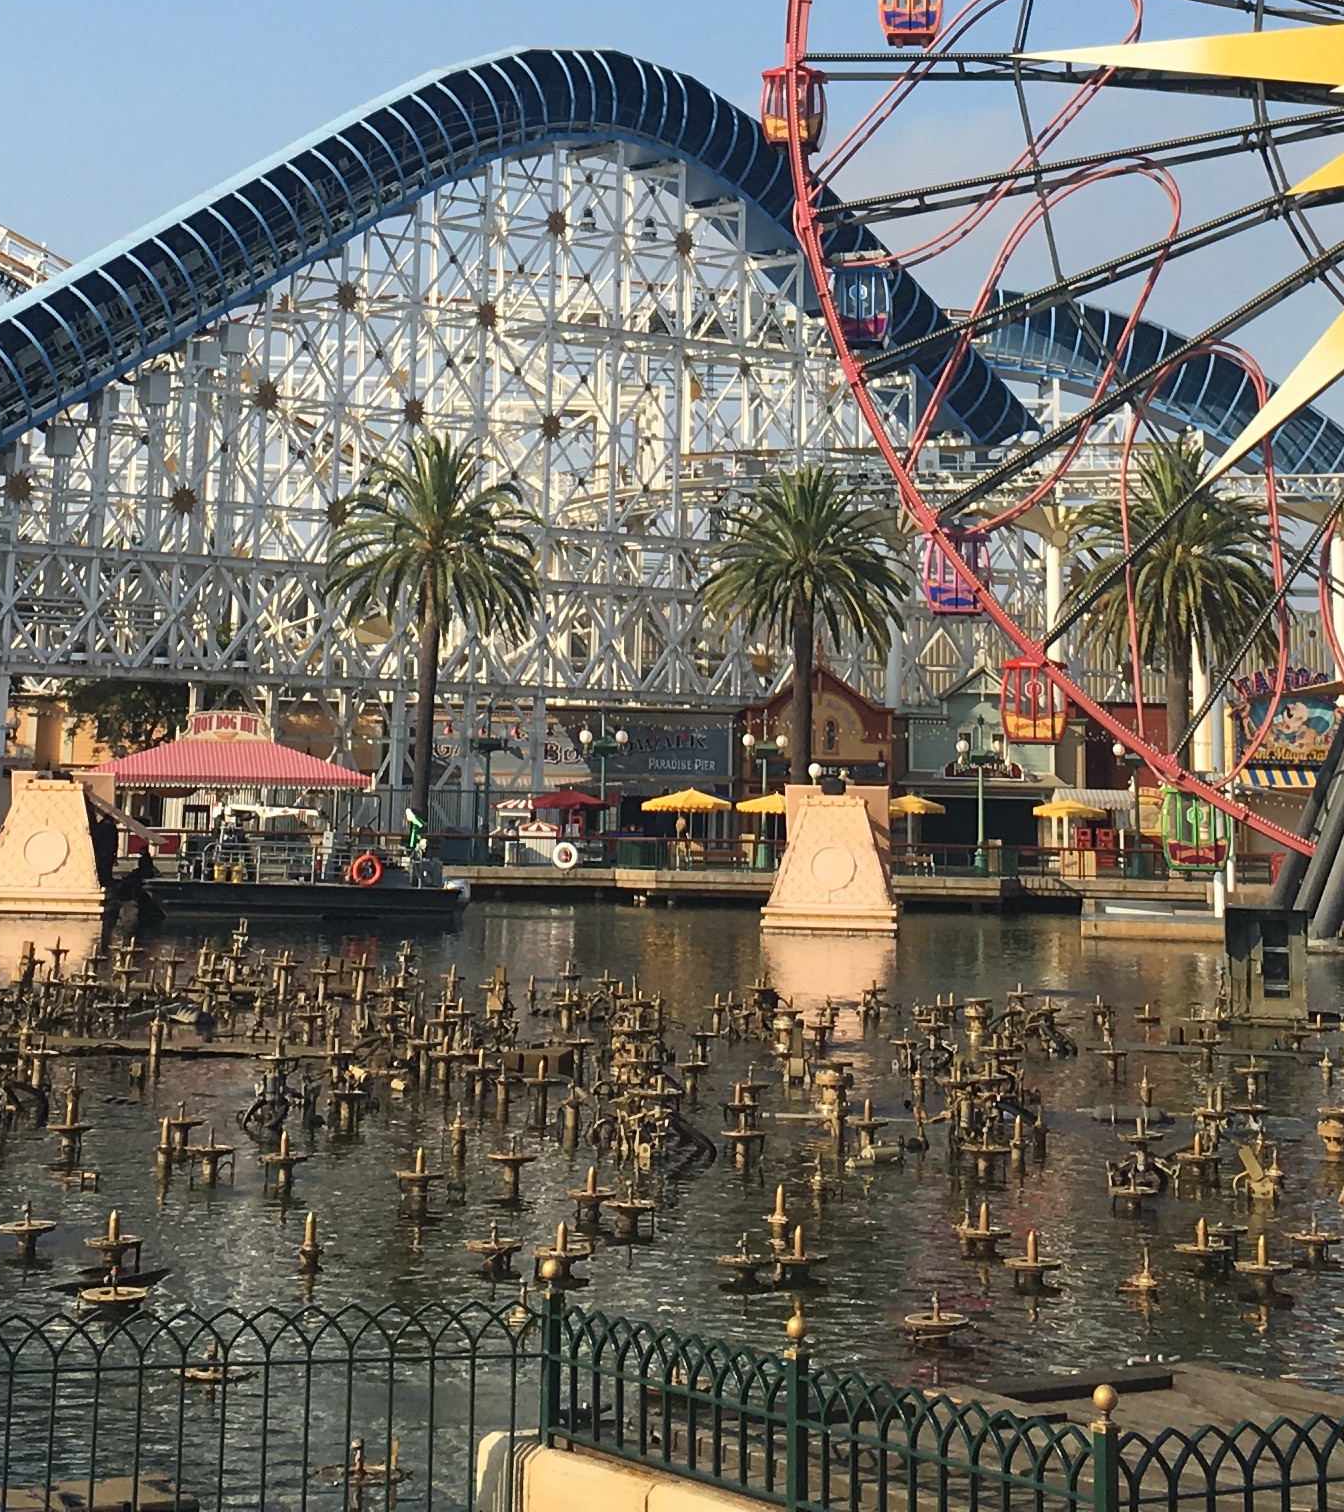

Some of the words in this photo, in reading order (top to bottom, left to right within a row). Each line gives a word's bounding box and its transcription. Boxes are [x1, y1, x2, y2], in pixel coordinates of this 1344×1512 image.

[193, 715, 214, 736] HOT
[216, 714, 237, 730] DOG
[240, 716, 259, 736] HUT
[543, 733, 709, 765] BOWALK
[648, 757, 692, 770] PARADISE
[694, 758, 716, 771] PIER
